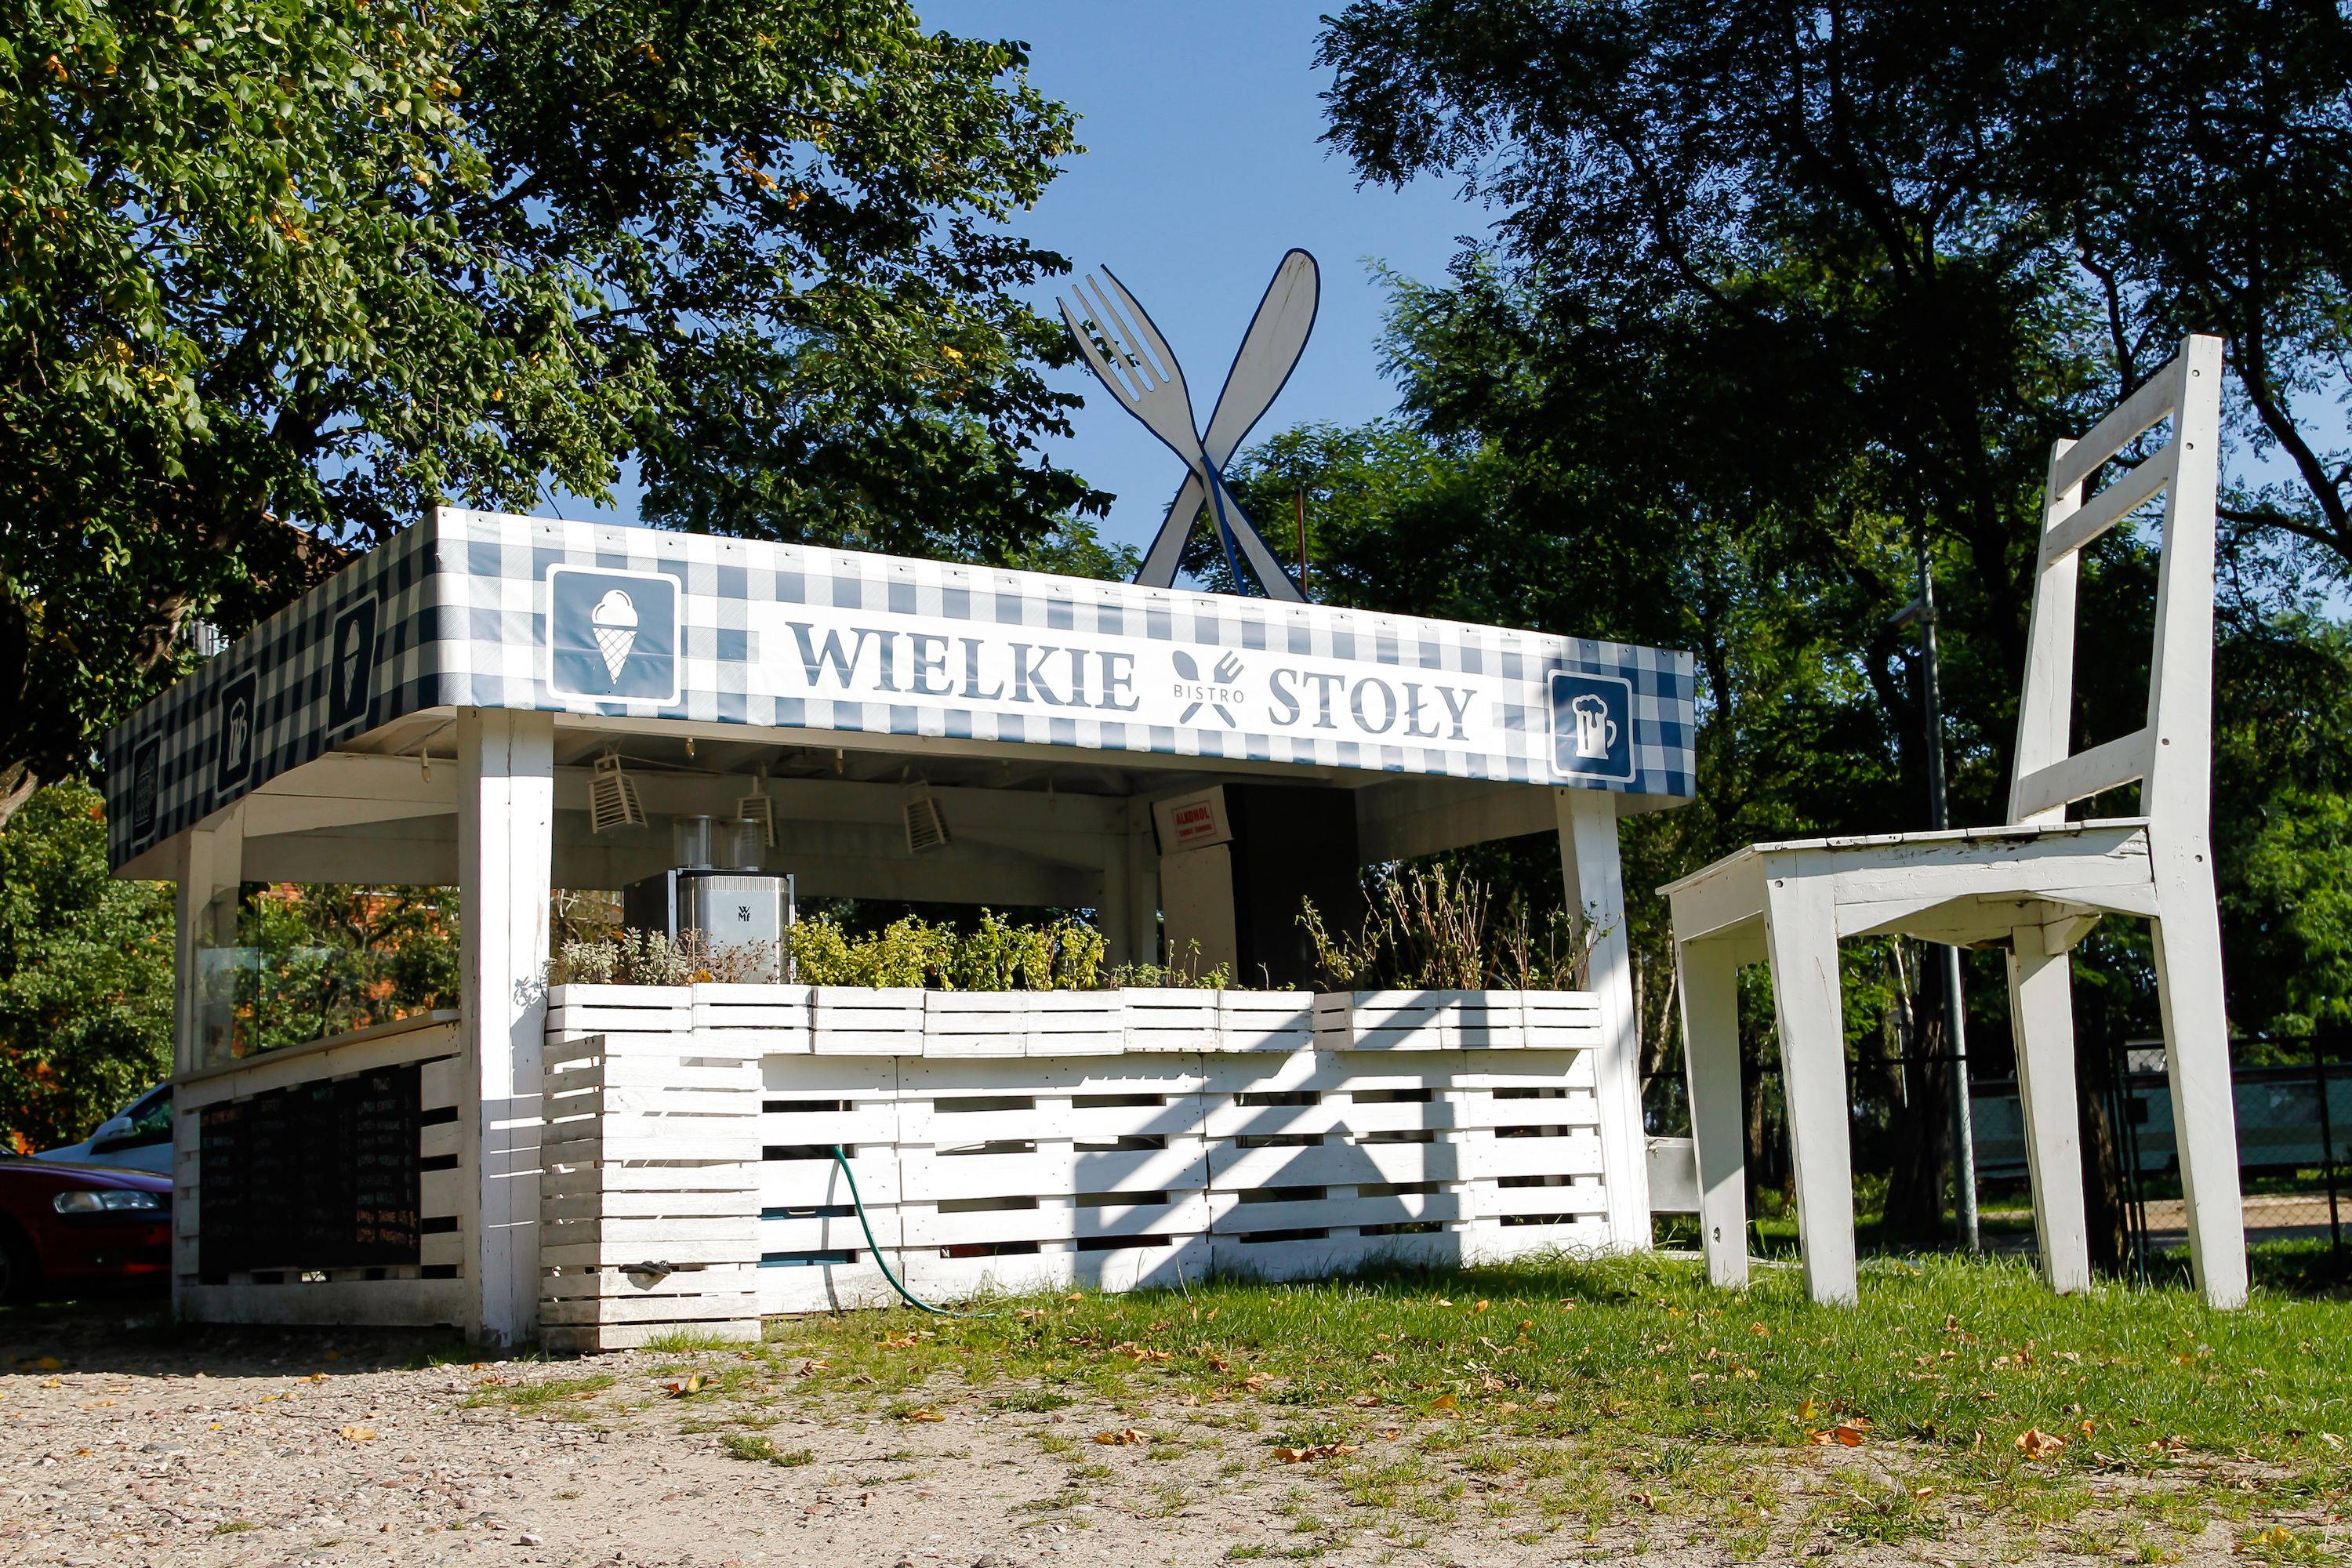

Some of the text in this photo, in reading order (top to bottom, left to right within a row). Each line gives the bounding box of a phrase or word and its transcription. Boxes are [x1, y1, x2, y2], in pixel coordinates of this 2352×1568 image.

[786, 621, 1478, 741] WIELKIE STOŁY
[1174, 684, 1244, 703] BISTRO
[1176, 807, 1210, 825] ALKOHOL
